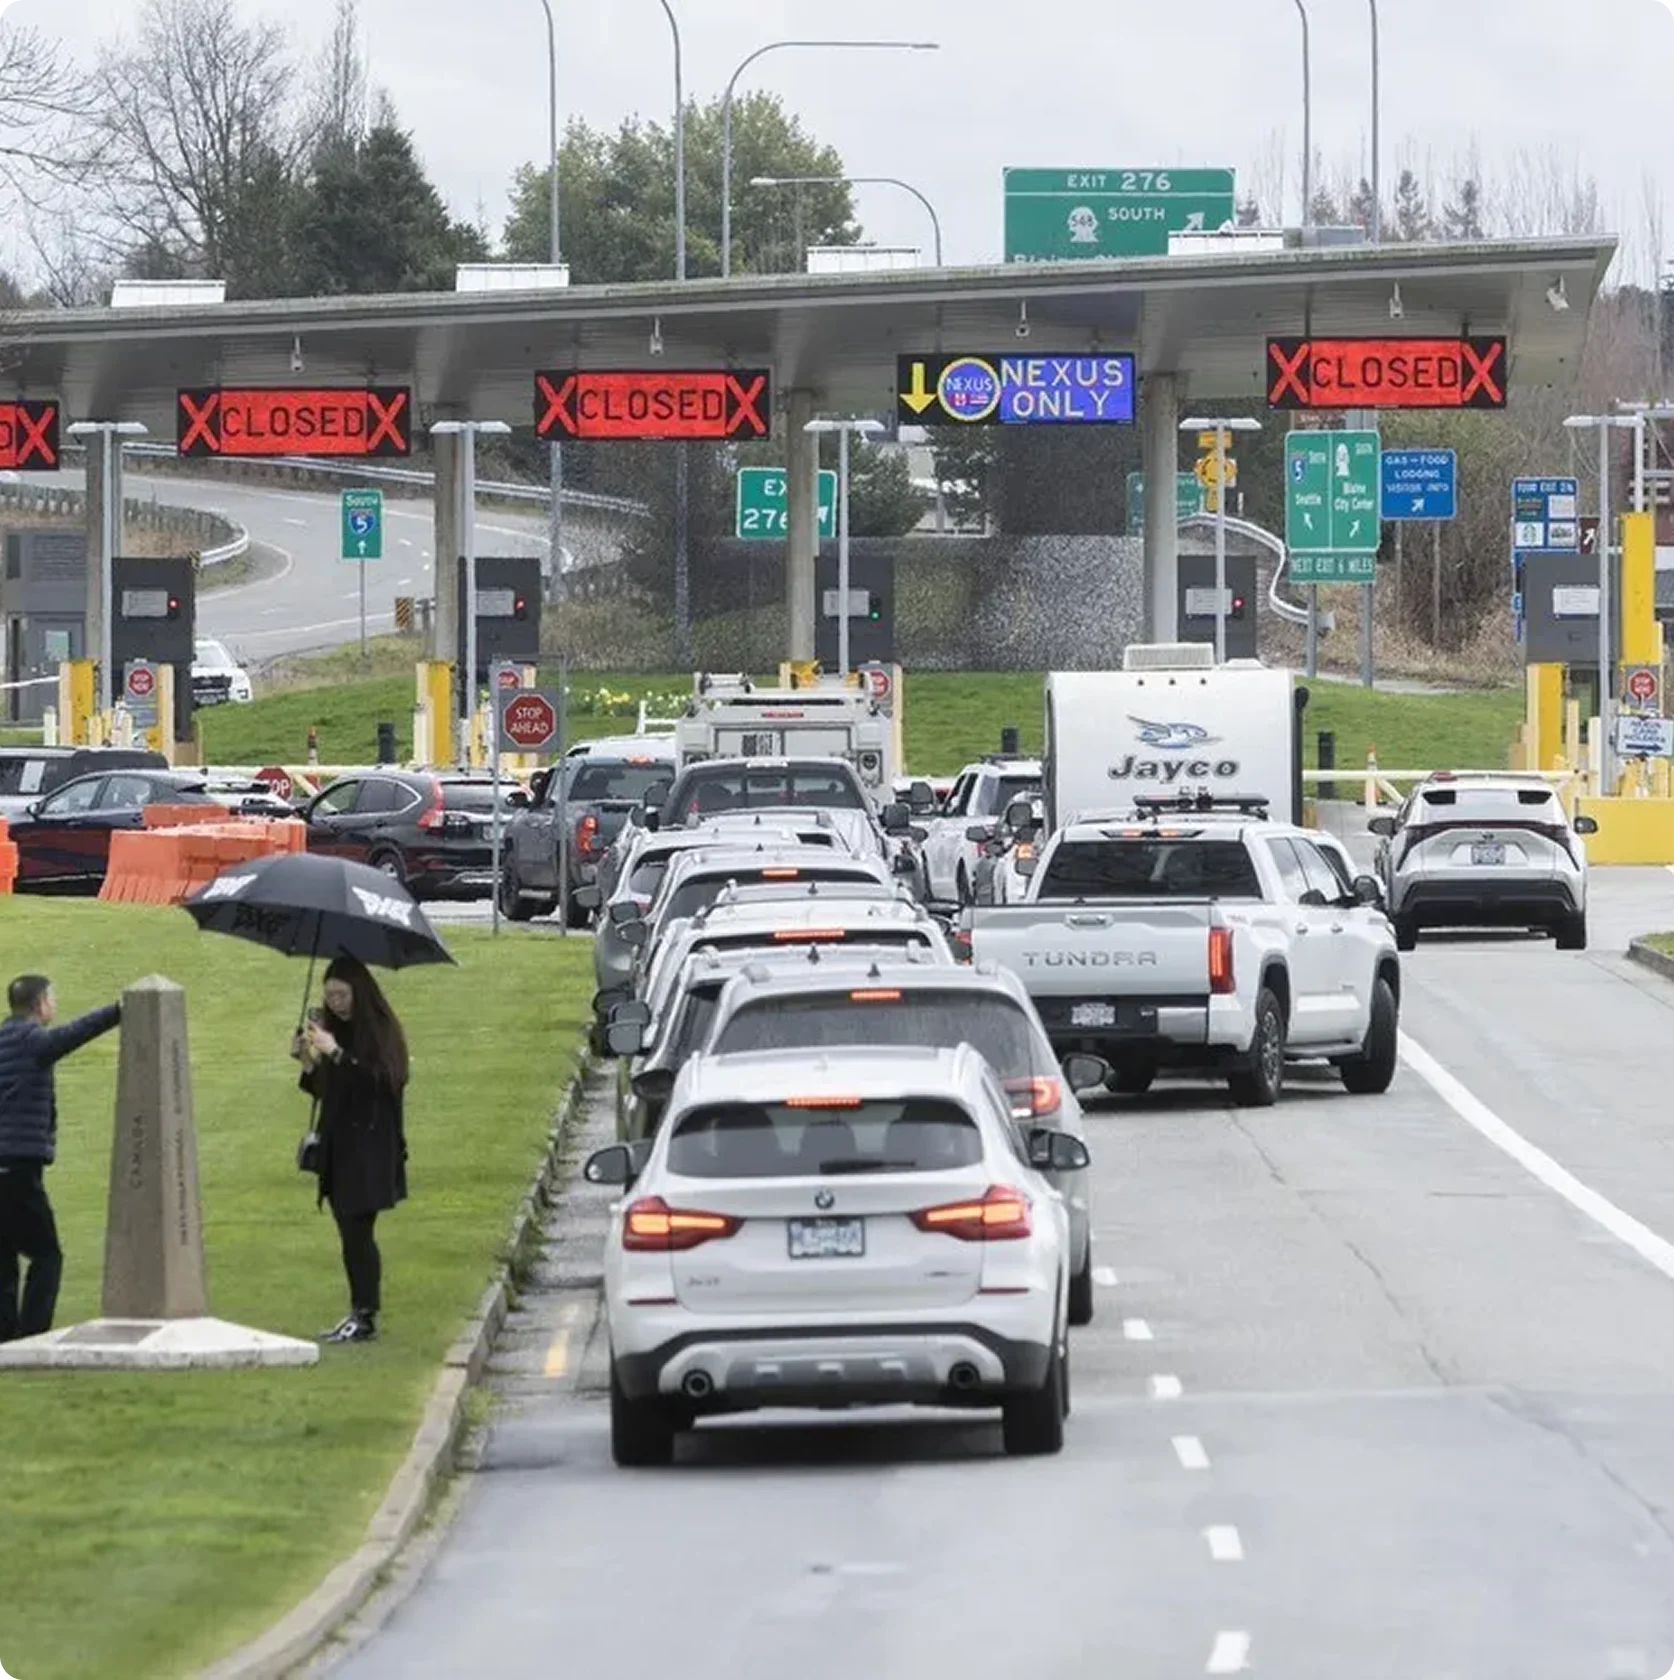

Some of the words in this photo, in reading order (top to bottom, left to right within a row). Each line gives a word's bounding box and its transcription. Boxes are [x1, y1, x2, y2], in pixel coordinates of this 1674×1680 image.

[1067, 175, 1107, 188] EXIT
[1121, 172, 1171, 191] 276
[1107, 206, 1166, 221] SOUTH
[1002, 359, 1123, 387] NEXUS
[1313, 357, 1458, 388] CLOSED
[946, 376, 993, 392] NEXUS
[580, 390, 723, 420] CLOSED
[1013, 390, 1110, 417] ONLY
[223, 407, 364, 436] CLOSED
[1420, 455, 1449, 465] FOOD
[1294, 460, 1303, 481] 5
[356, 516, 368, 534] 5
[516, 707, 543, 720] STOP
[510, 721, 549, 734] AHEAD
[1108, 755, 1239, 784] Jayco
[1023, 951, 1158, 966] TUNDRA
